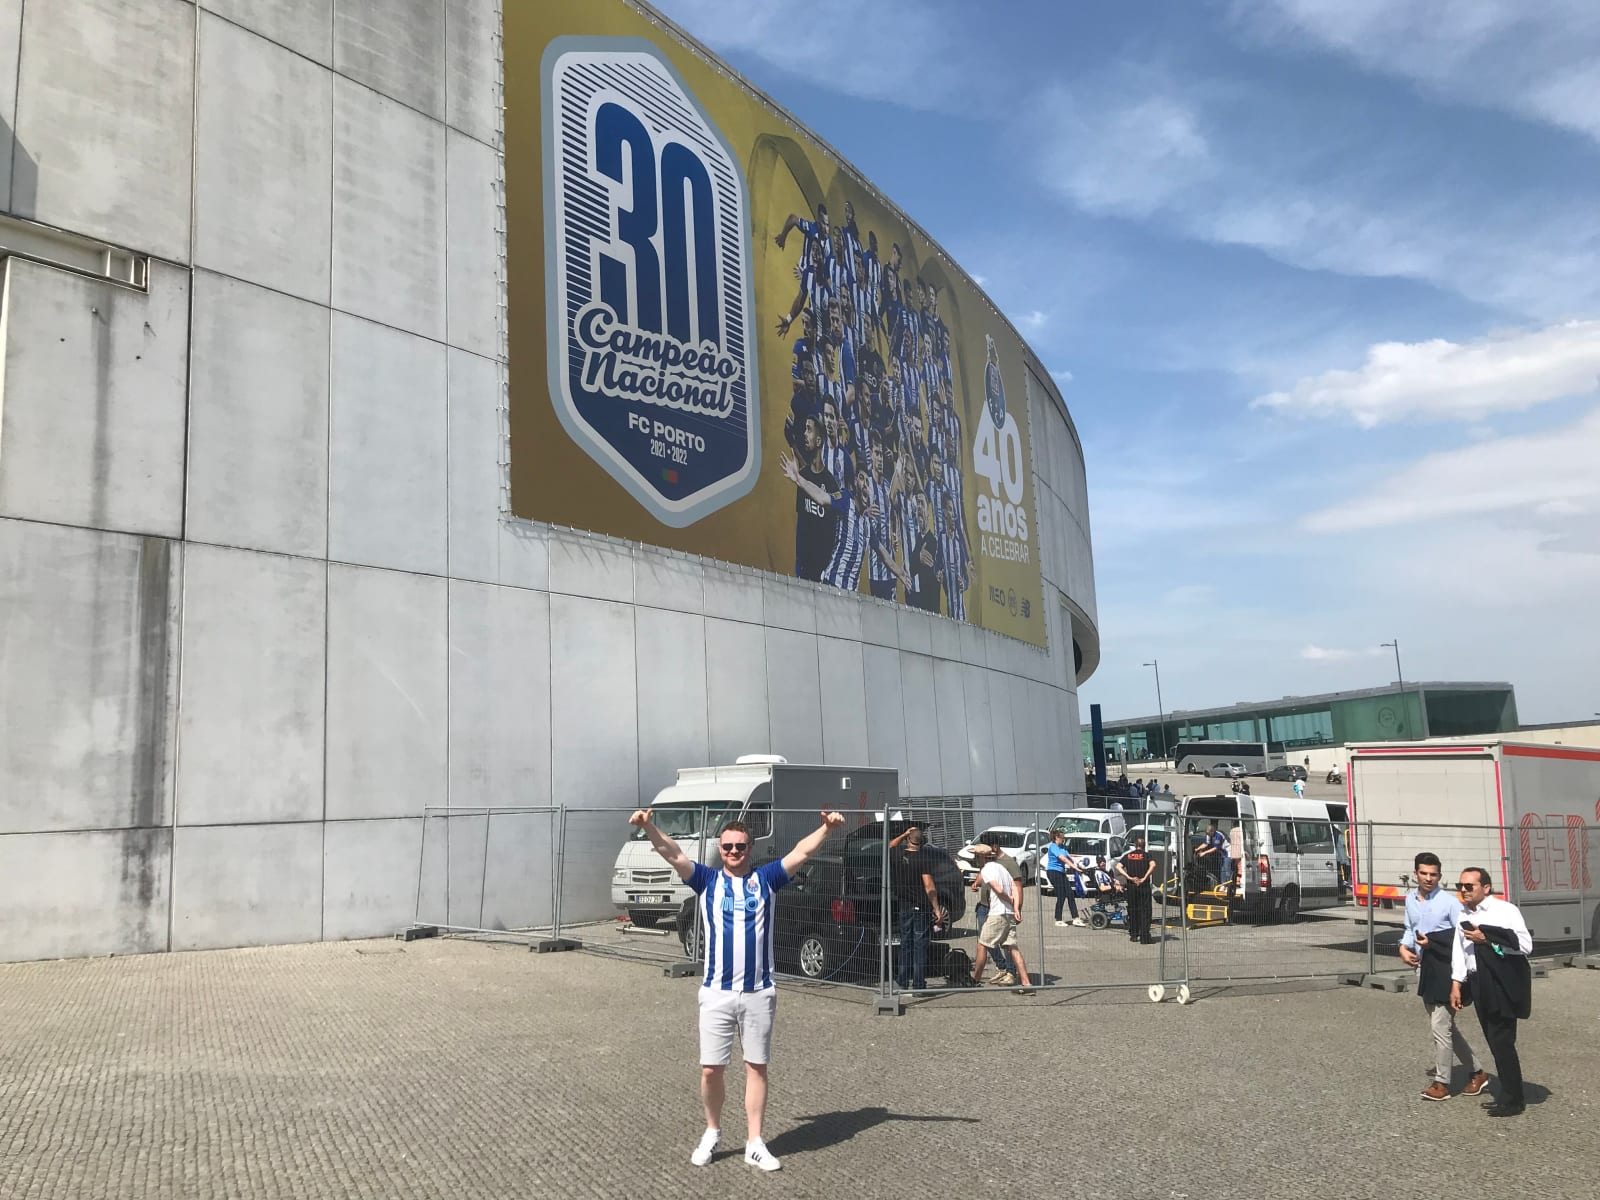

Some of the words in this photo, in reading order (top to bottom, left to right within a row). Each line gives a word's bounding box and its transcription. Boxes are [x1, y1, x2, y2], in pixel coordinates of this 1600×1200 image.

[595, 102, 721, 349] 30
[579, 308, 737, 379] Campeão
[586, 351, 731, 412] Nacional
[628, 412, 650, 434] FC
[654, 421, 706, 452] PORTO
[650, 438, 666, 459] 2021
[671, 445, 688, 466] 2022
[973, 399, 1023, 506] 40
[977, 494, 1029, 541] anos
[981, 534, 988, 558] A
[989, 535, 1031, 566] CELEBRAR
